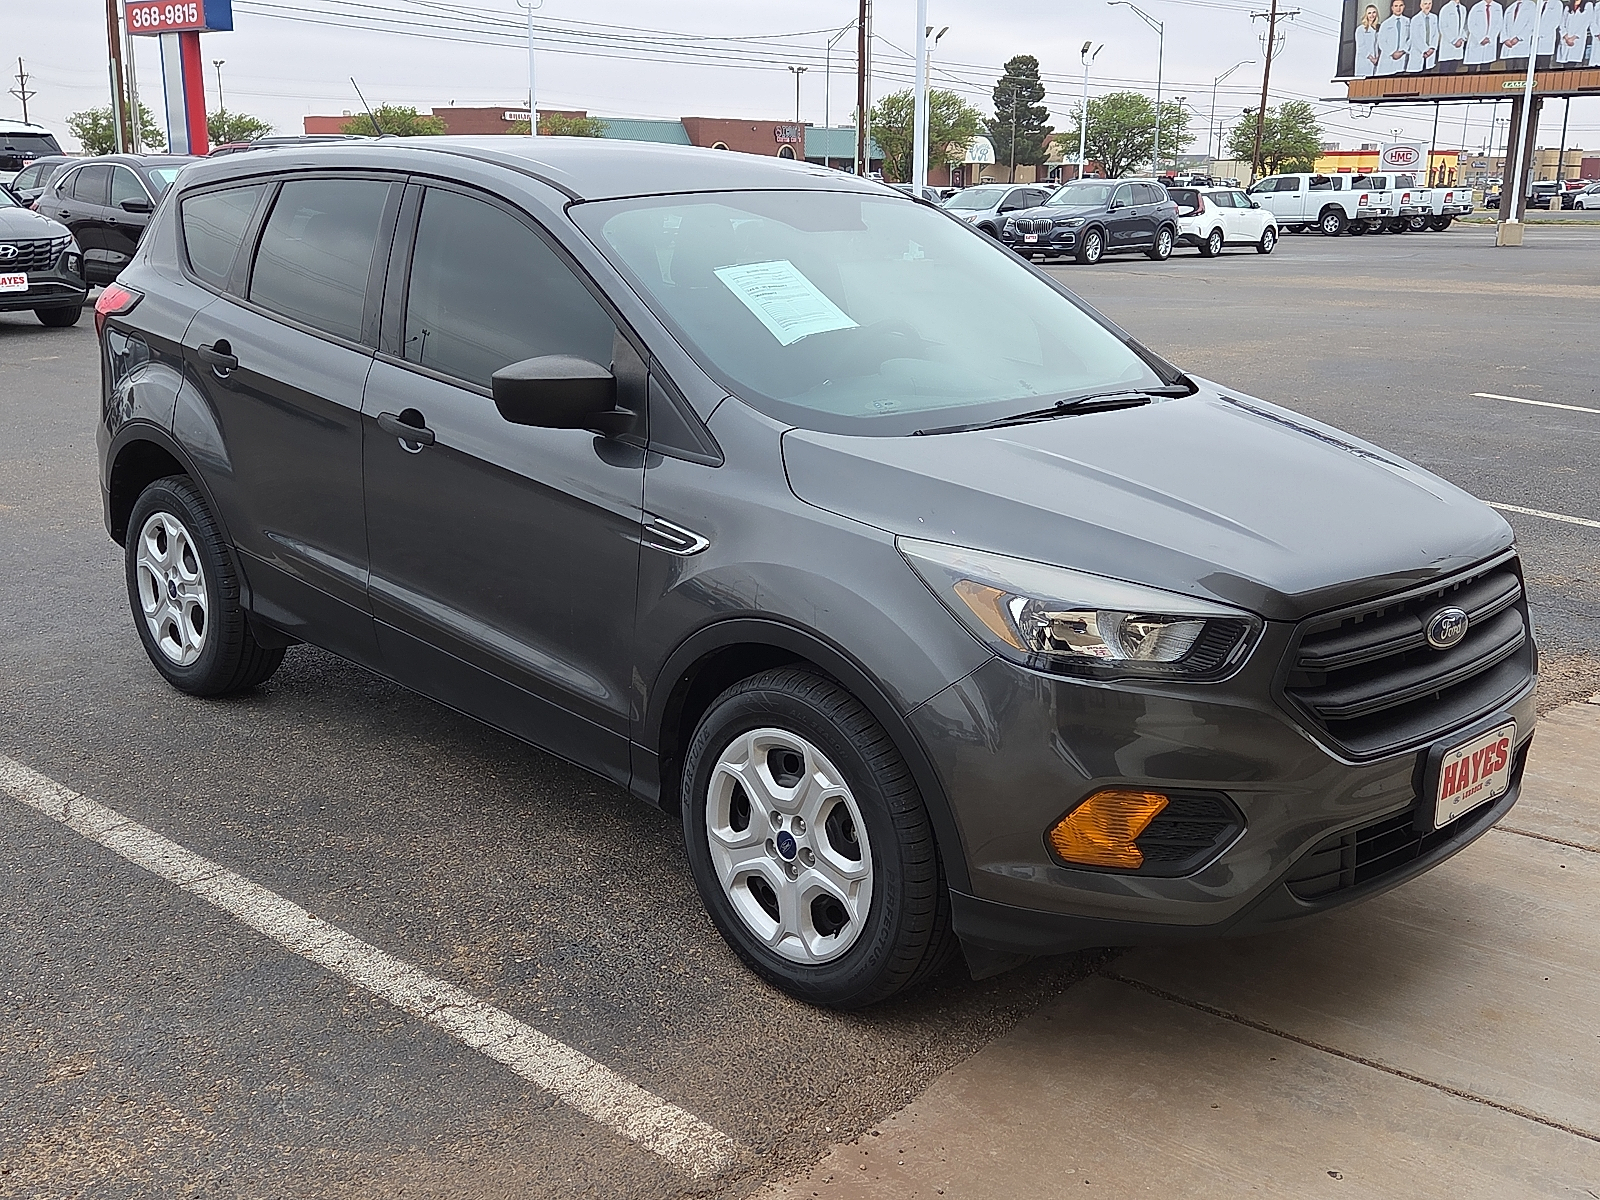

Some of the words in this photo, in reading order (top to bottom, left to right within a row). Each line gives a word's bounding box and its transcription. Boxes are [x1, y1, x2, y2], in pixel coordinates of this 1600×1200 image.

[132, 2, 198, 28] 368-9815
[1390, 151, 1412, 162] HMC
[0, 277, 25, 286] AYES
[683, 725, 711, 810] FORTUNE
[1441, 737, 1510, 801] HAYES
[868, 866, 896, 968] PERFECTUS
